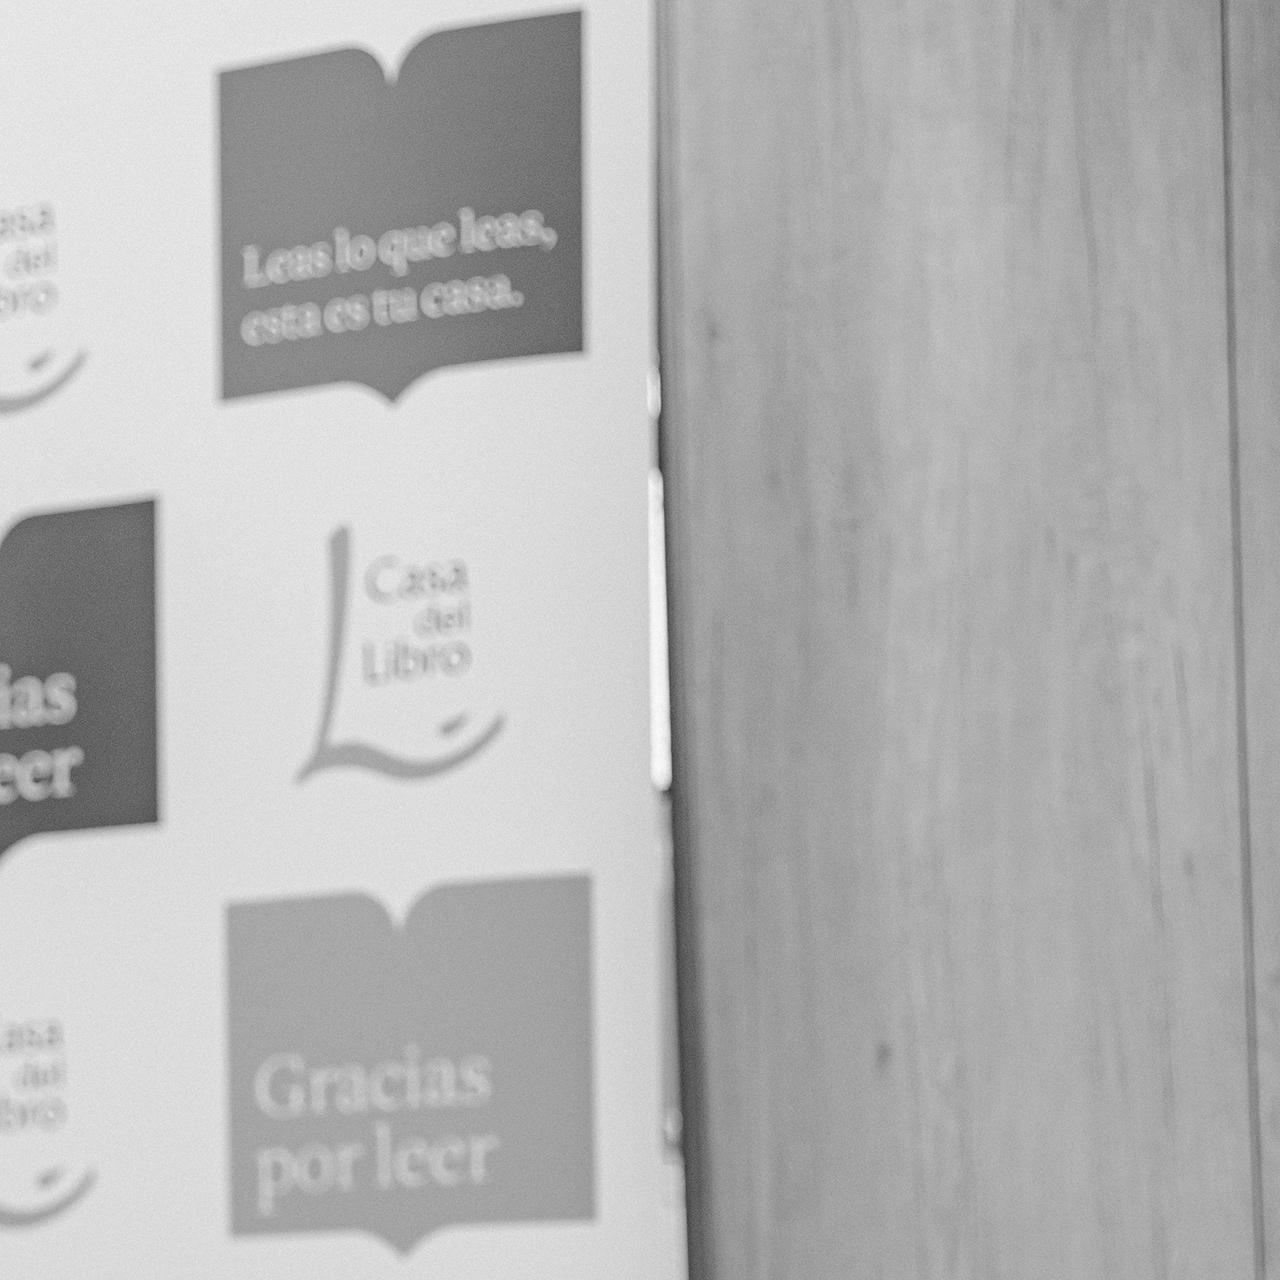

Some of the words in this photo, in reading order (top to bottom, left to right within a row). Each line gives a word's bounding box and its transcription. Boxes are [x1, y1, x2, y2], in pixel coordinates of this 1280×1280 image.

[242, 241, 334, 288] Leas
[333, 227, 377, 273] lo
[378, 221, 457, 278] que
[457, 206, 558, 253] leas,
[240, 301, 322, 347] esta
[323, 294, 371, 334] es
[372, 287, 419, 326] tu
[419, 273, 524, 319] casa.
[364, 555, 468, 605] Casa
[413, 601, 473, 638] del
[362, 638, 473, 686] Libro
[254, 1042, 494, 1121] Gracias
[256, 1138, 365, 1217] por
[374, 1119, 501, 1191] leer
